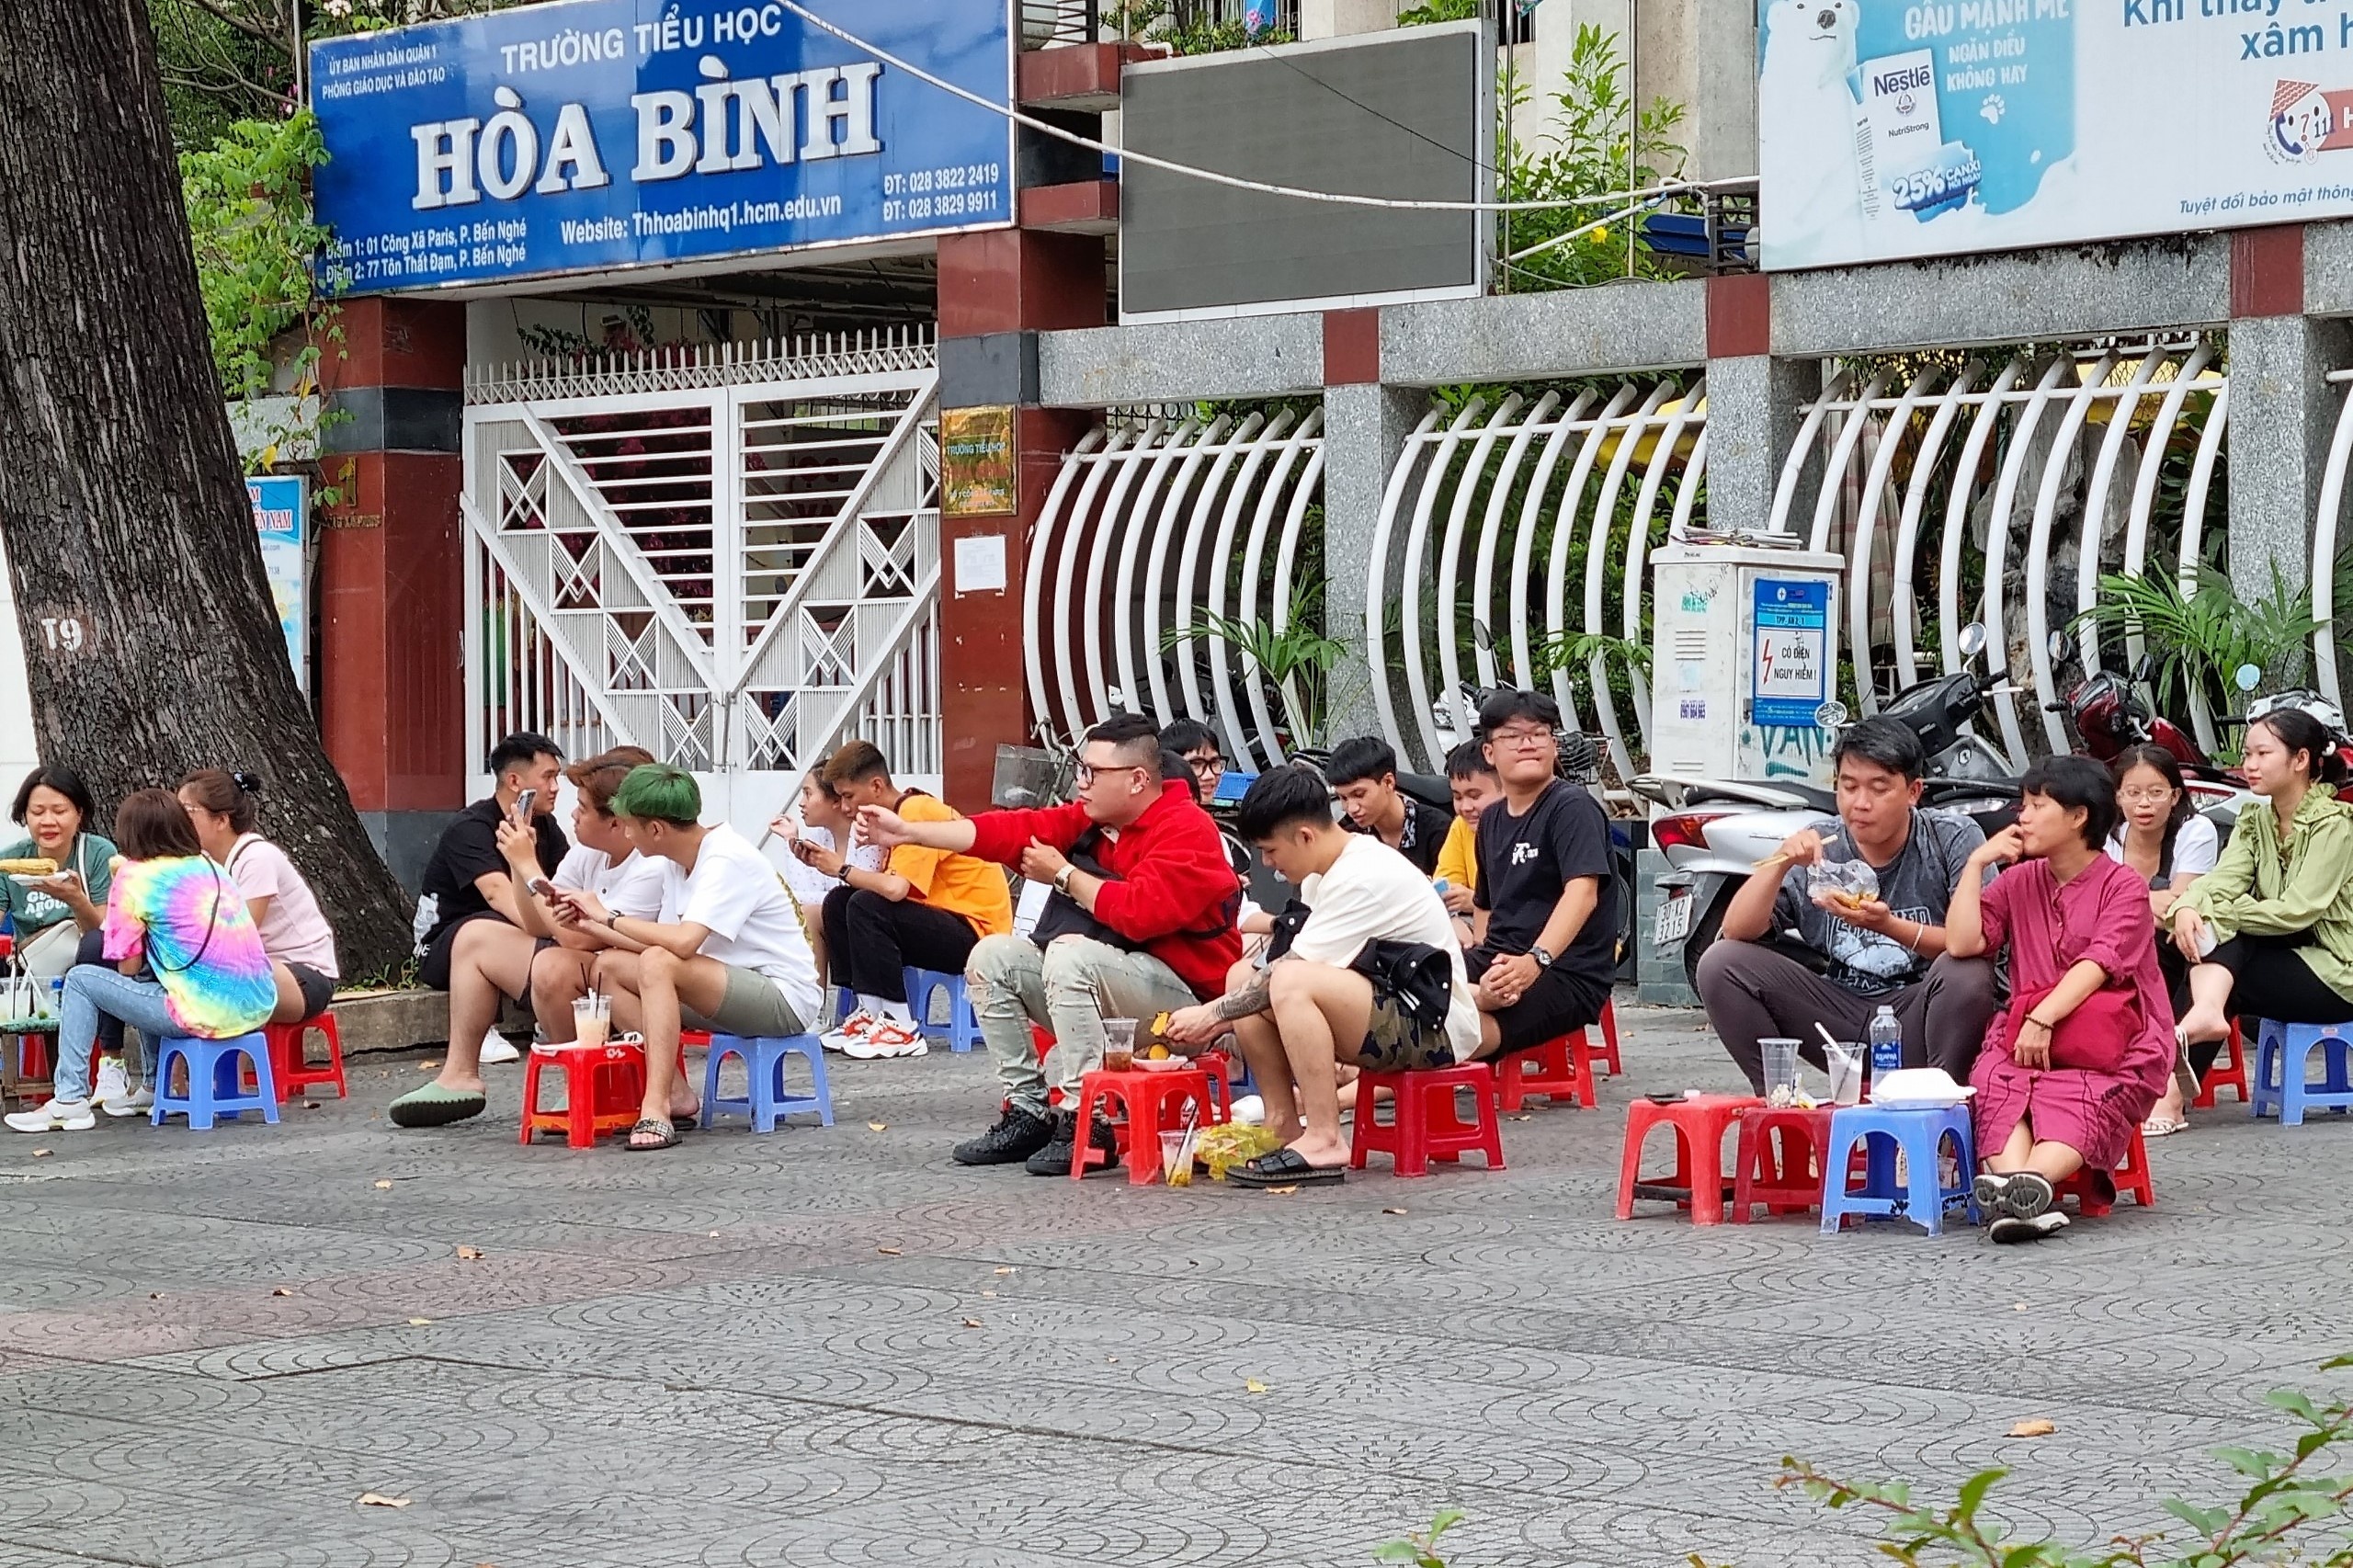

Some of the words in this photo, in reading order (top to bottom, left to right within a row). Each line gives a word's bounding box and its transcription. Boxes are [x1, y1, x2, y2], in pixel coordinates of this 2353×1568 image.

[500, 28, 624, 74] TRƯỜNG
[633, 3, 703, 54] TIỂU
[713, 4, 781, 45] HỌC
[2241, 21, 2324, 61] xâm
[342, 56, 360, 73] BAN
[361, 50, 385, 70] NHÂN
[405, 42, 430, 63] QUẬN
[431, 44, 437, 59] 1
[322, 80, 351, 100] PHÒNG
[353, 75, 373, 95] GIÁO
[375, 75, 393, 93] DỤC
[394, 70, 405, 88] VÀ
[407, 67, 426, 85] ĐÀO
[427, 66, 446, 85] TẠO
[1947, 65, 1995, 92] KHÔNG
[2001, 63, 2028, 85] HAY
[411, 85, 613, 210] HÒA
[631, 55, 884, 181] BÌNH
[1888, 122, 1929, 138] NutriStrong
[884, 174, 906, 195] ĐT:
[909, 170, 932, 193] 028
[935, 166, 965, 189] 3822
[968, 163, 999, 186] 2419
[1893, 165, 1946, 209] 25%
[1946, 159, 1981, 181] CANXI
[883, 200, 905, 222] ĐT:
[908, 198, 931, 220] 028
[935, 193, 964, 216] 3829
[968, 189, 996, 212] 9911
[2180, 198, 2216, 215] Tuyệt
[2221, 192, 2244, 210] đối
[2249, 190, 2278, 207] bảo
[2283, 187, 2313, 206] mật
[561, 219, 629, 245] Website:
[632, 194, 842, 236] Thhoabinhq1.hcm.edu.vn
[355, 239, 365, 256] 1:
[367, 236, 378, 256] 01
[381, 233, 409, 257] Công
[412, 231, 426, 250] Xã
[428, 226, 458, 249] Paris,
[460, 225, 471, 244] P.
[473, 219, 495, 243] Bến
[497, 217, 527, 244] Nghé
[355, 264, 365, 282] 2:
[367, 261, 379, 278] 77
[381, 258, 402, 277] Tôn
[404, 251, 427, 273] Thất
[430, 253, 458, 274] Đạm,
[460, 249, 471, 268] P.
[473, 244, 495, 267] Bến
[497, 242, 526, 267] Nghé
[269, 512, 291, 529] NAM
[41, 618, 83, 652] T9
[1782, 645, 1791, 658] CÓ
[1774, 667, 1793, 679] NGUY
